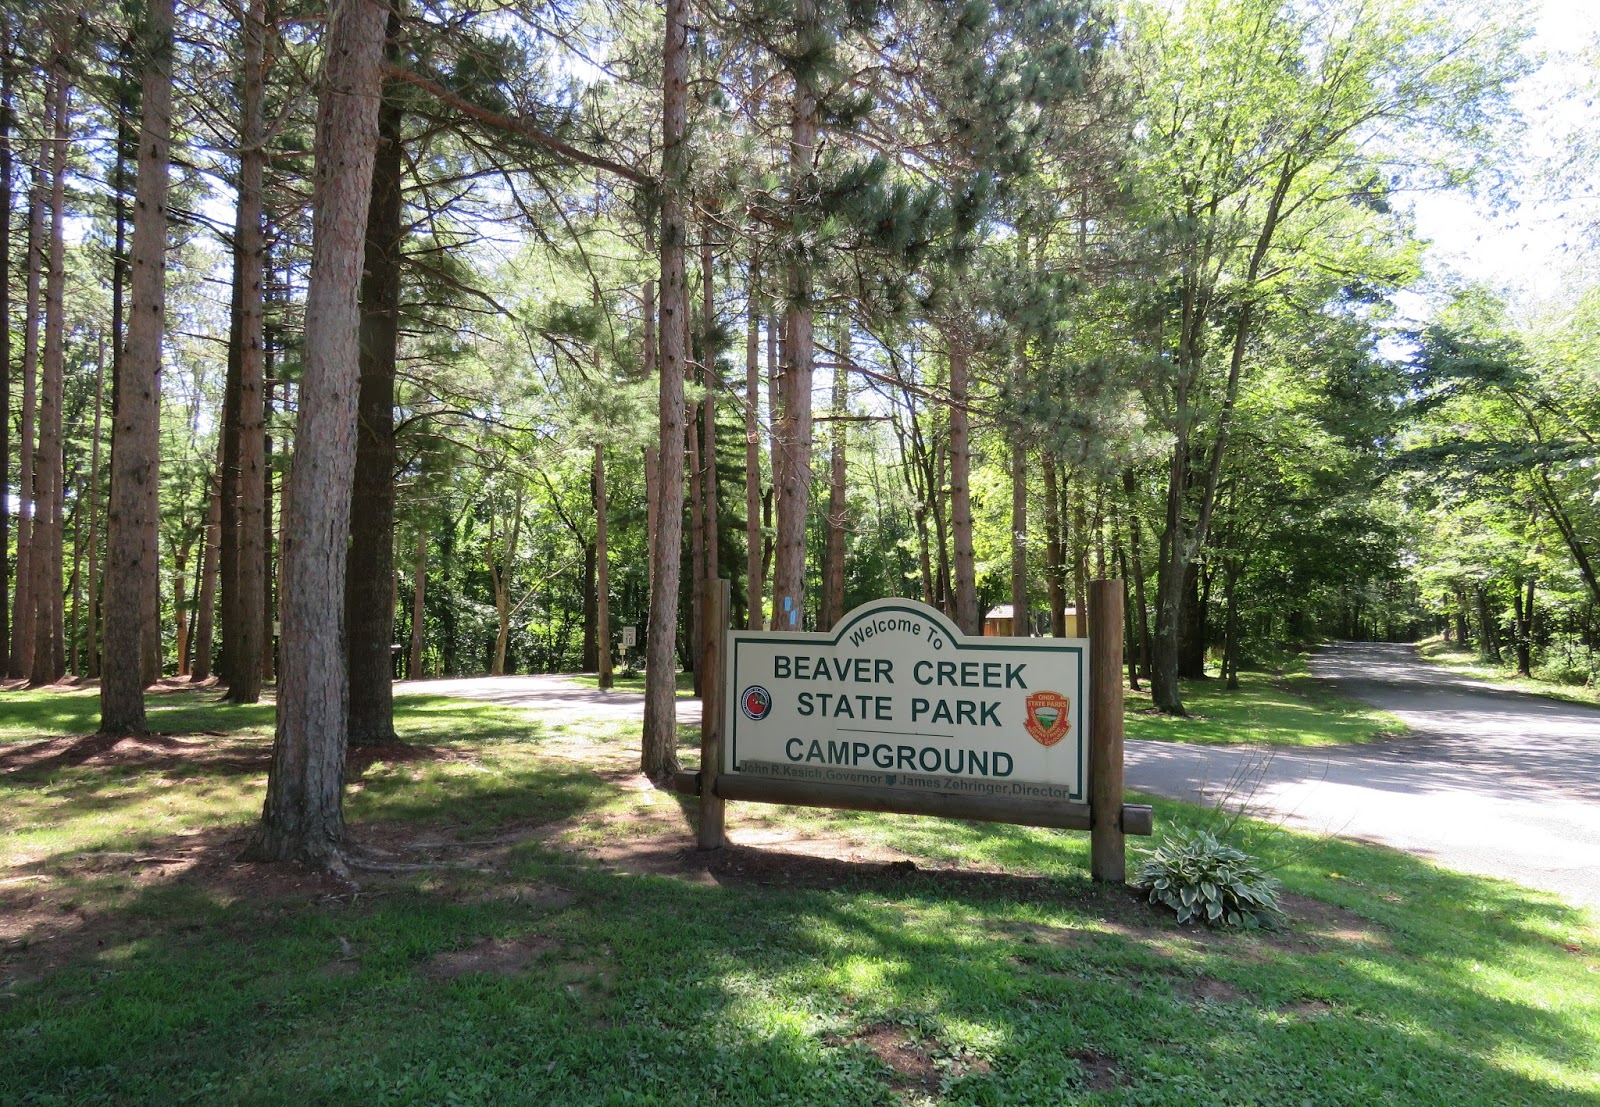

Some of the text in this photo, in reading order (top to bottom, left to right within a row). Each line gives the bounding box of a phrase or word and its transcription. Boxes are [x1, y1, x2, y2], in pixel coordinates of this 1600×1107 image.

[849, 619, 943, 650] Welcome To
[774, 655, 1028, 689] BEAVER CREEK
[797, 692, 893, 721] STATE
[911, 698, 1003, 727] PARK
[785, 738, 1014, 777] CAMPGROUND
[741, 762, 769, 774] John
[900, 775, 941, 789] James
